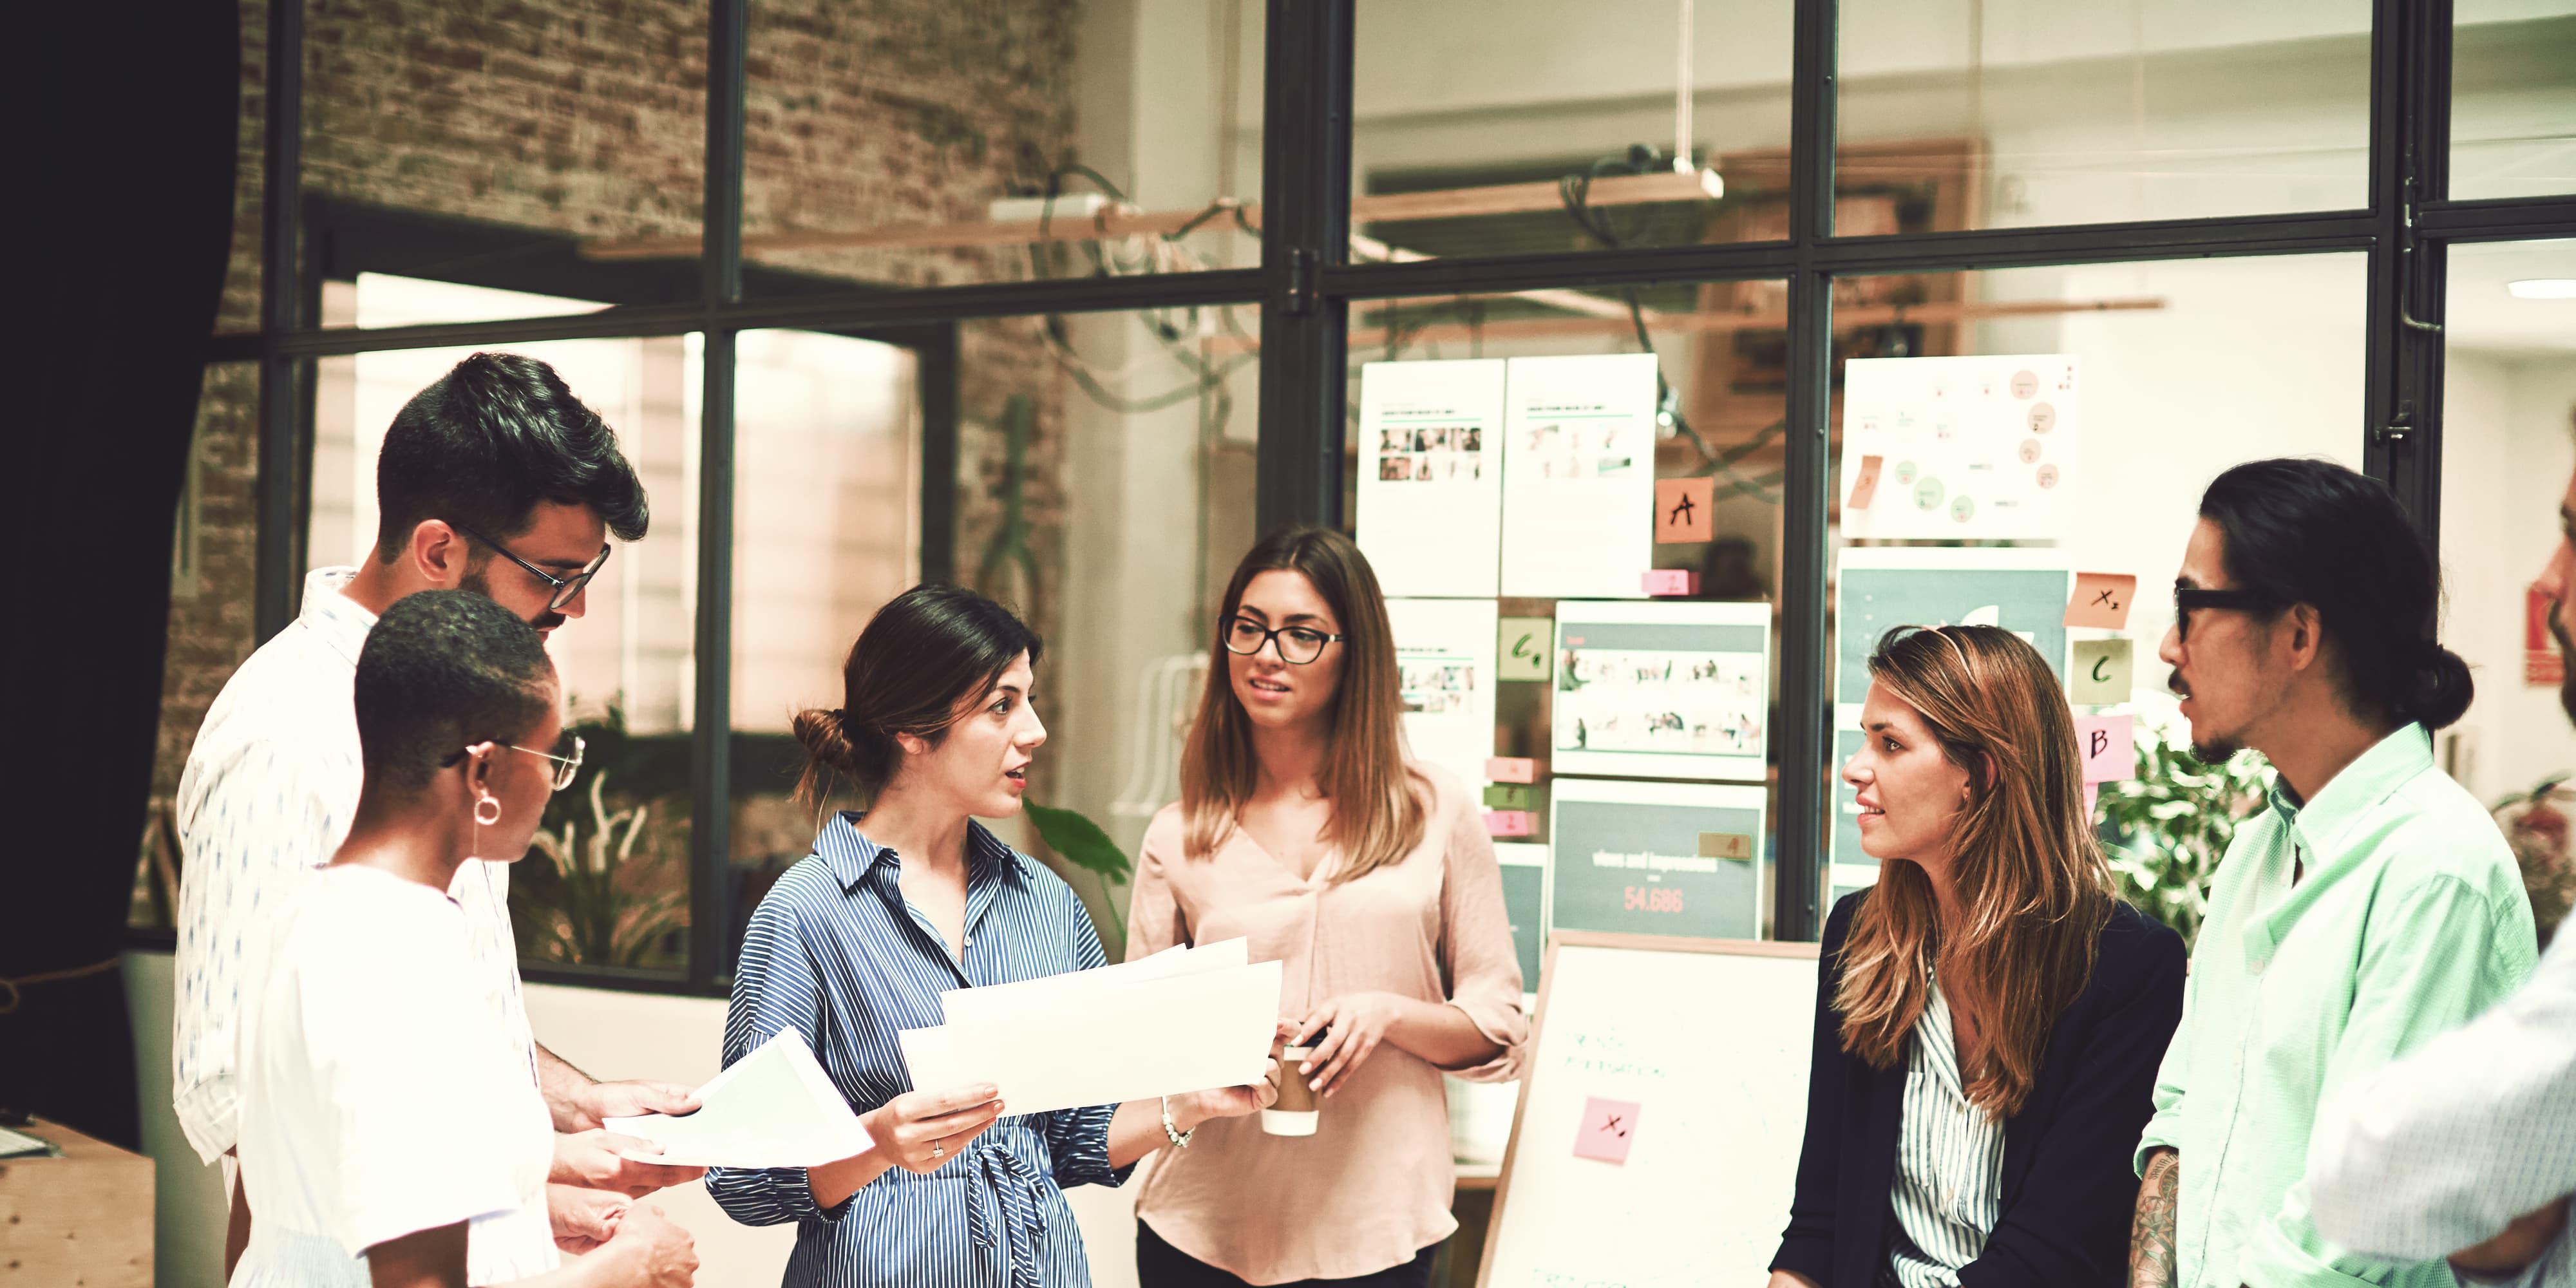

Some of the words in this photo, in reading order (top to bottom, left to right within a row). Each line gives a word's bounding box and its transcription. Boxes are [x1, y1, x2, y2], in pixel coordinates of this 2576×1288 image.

[1670, 493, 1694, 526] A
[2092, 656, 2112, 683] C
[2091, 730, 2108, 759] B
[1592, 849, 1625, 867] views
[1626, 850, 1647, 869] and
